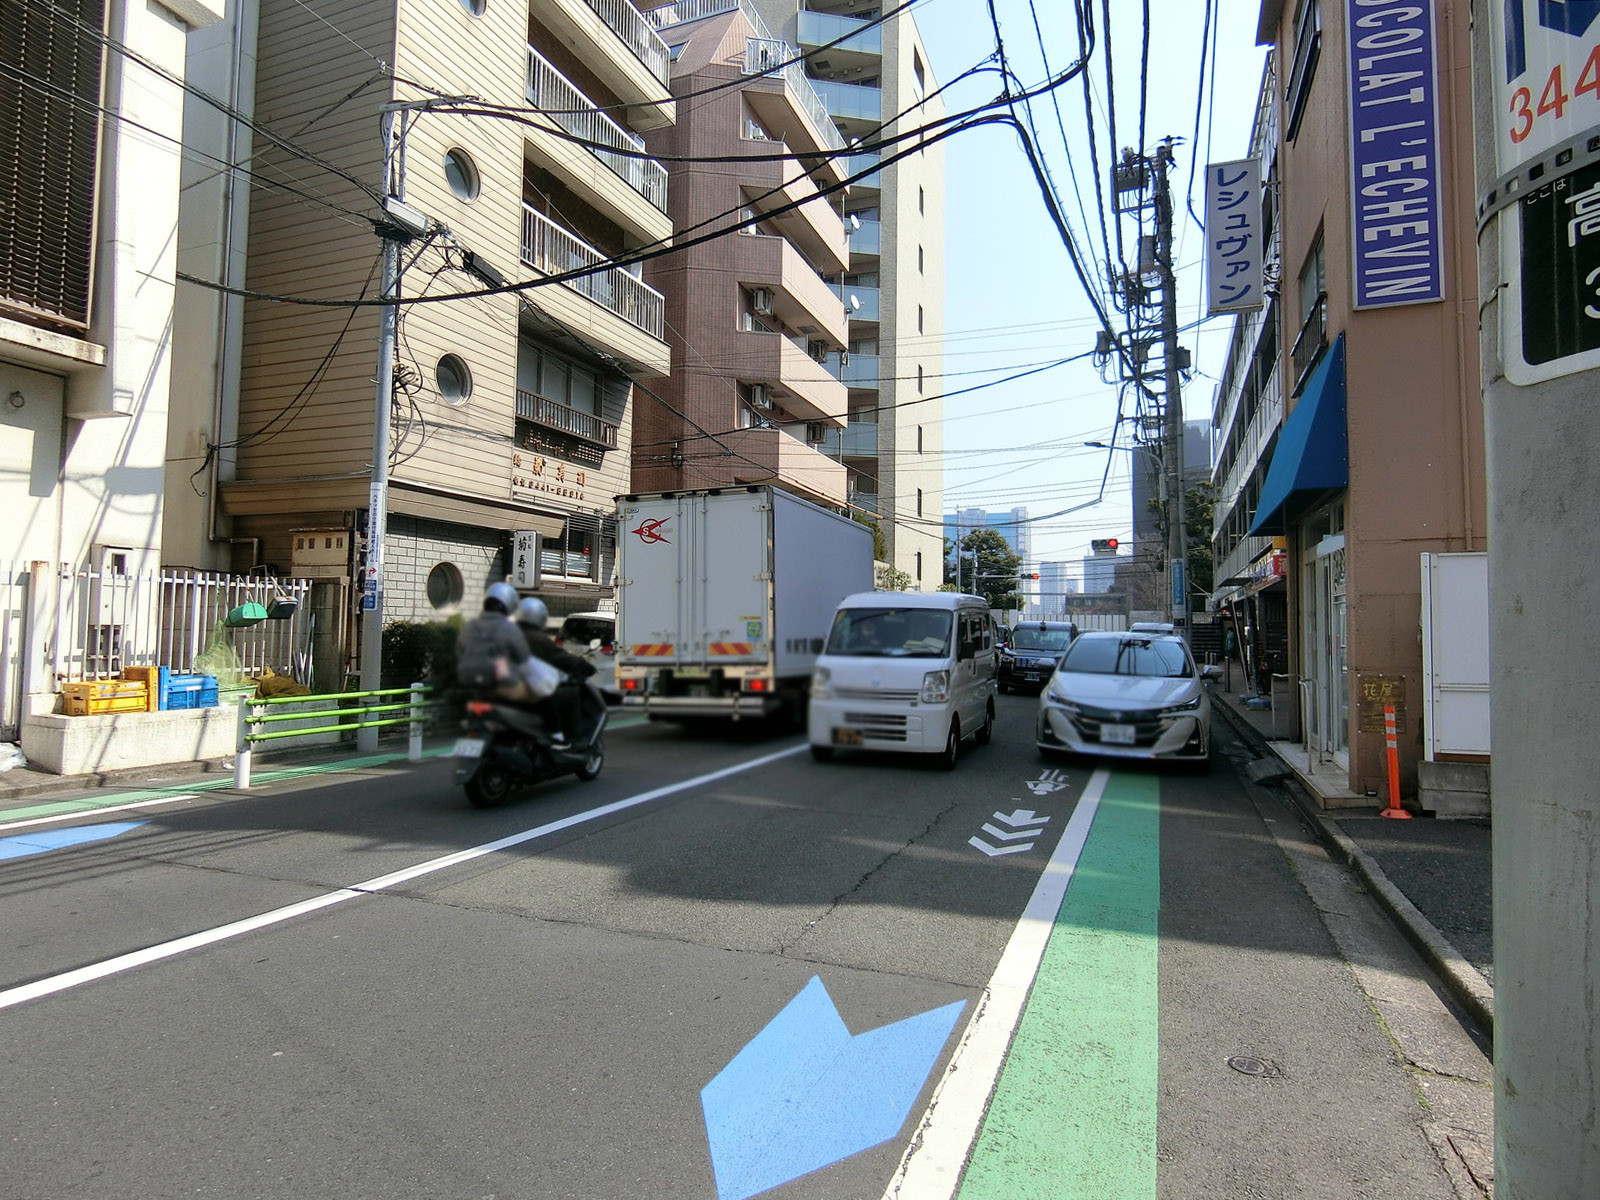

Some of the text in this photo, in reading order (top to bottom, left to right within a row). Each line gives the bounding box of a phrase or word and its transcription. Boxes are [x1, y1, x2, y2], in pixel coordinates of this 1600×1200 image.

[1355, 0, 1431, 299] COLAT L'ECHEVIN
[1527, 178, 1567, 205] ここは
[1216, 168, 1252, 304] レシュヴァン
